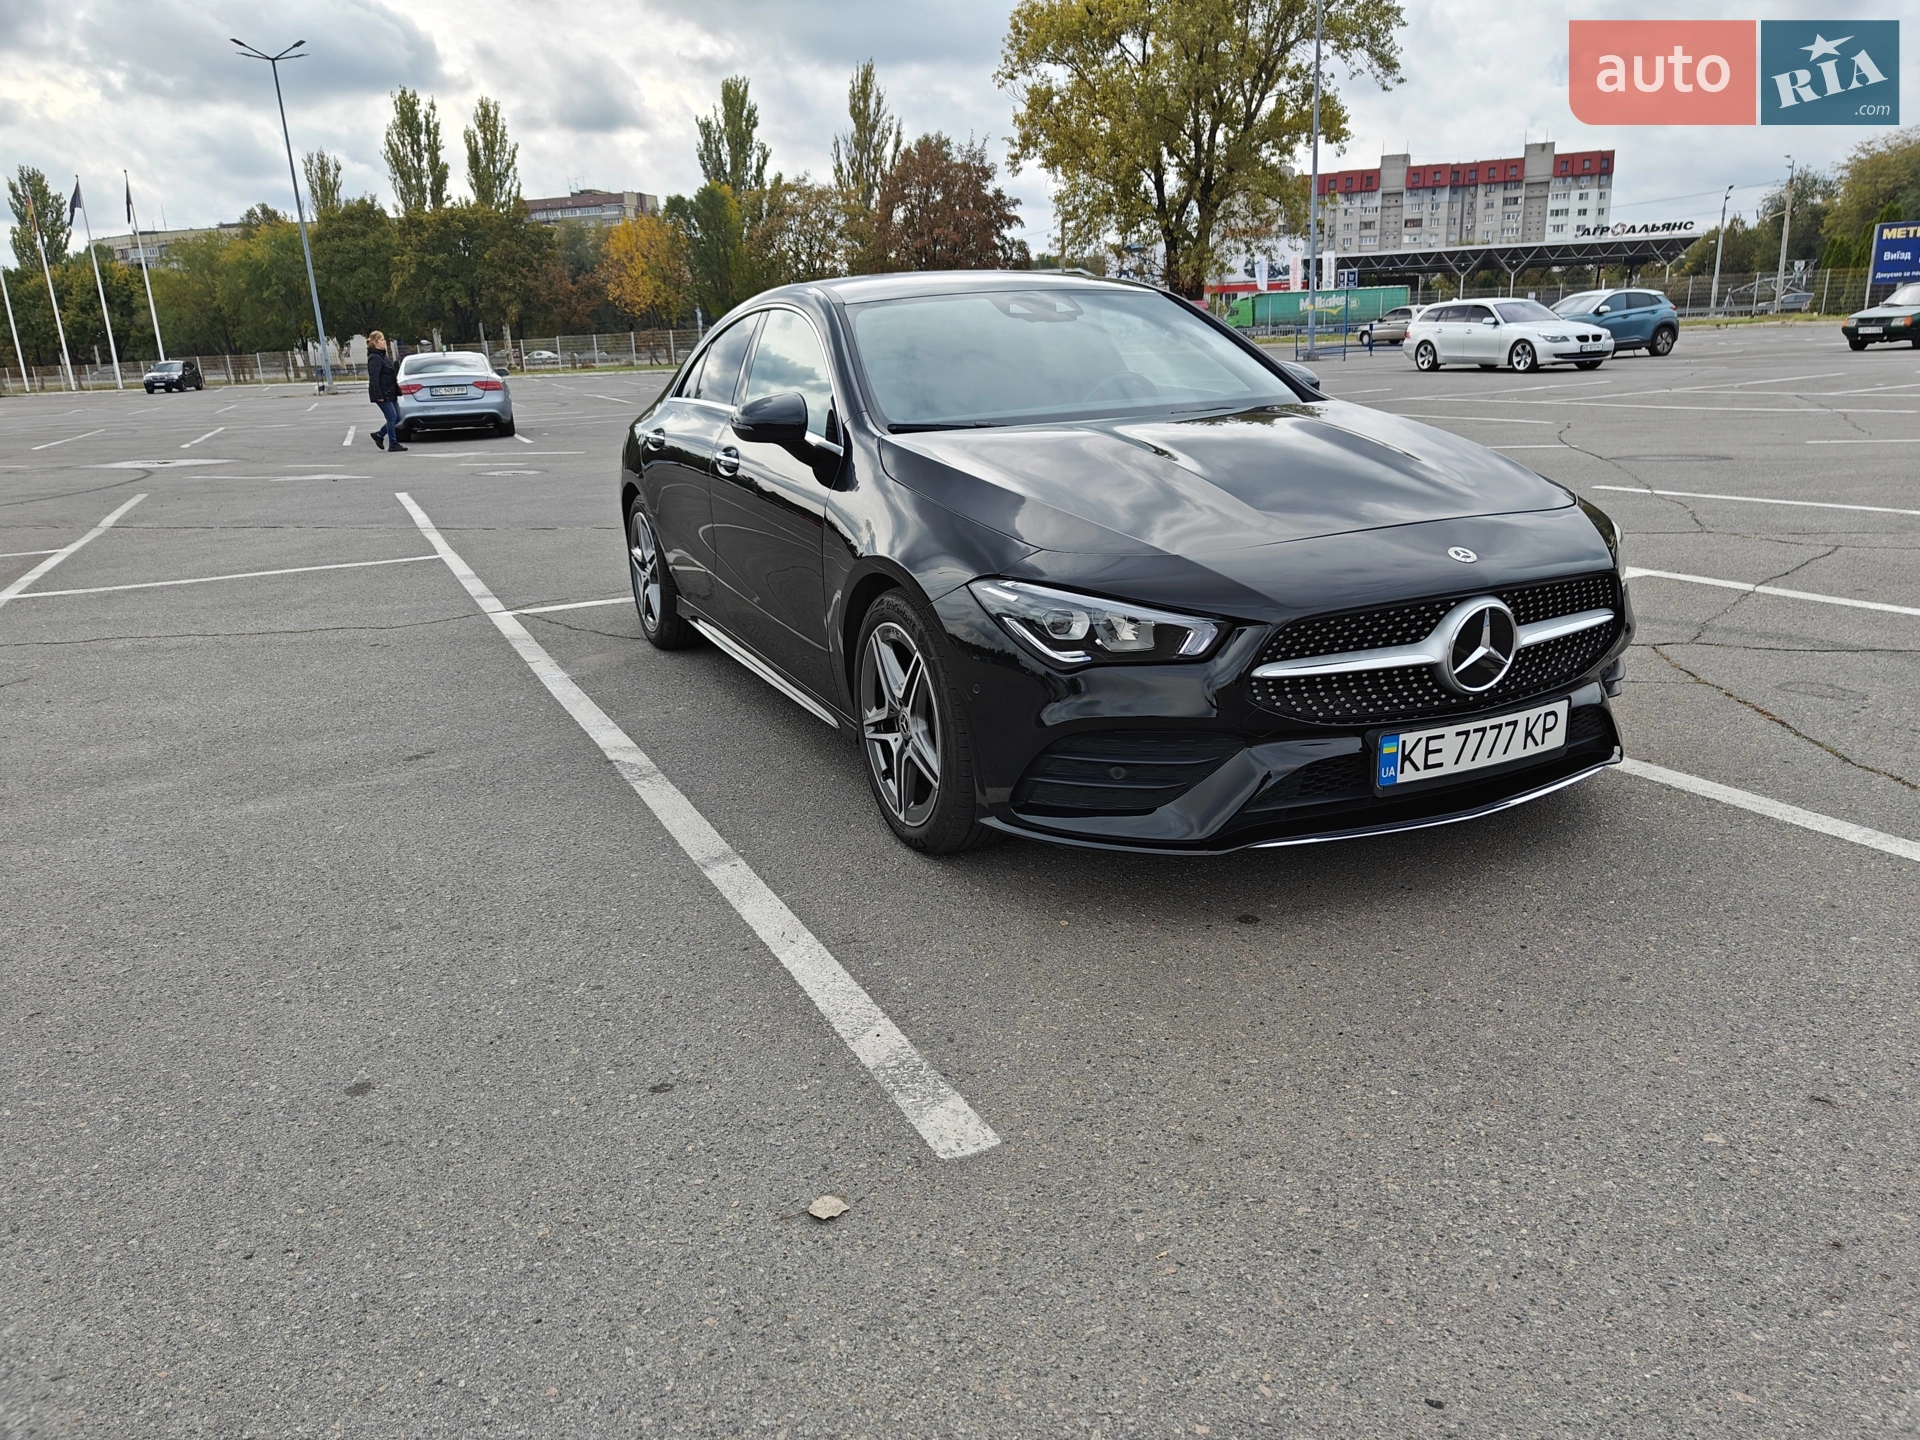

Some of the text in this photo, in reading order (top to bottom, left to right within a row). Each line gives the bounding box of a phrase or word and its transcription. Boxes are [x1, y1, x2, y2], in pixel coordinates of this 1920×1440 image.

[1883, 250, 1911, 261] Виїзд
[1399, 709, 1559, 775] KE 7777 KP
[1381, 765, 1396, 778] UA
